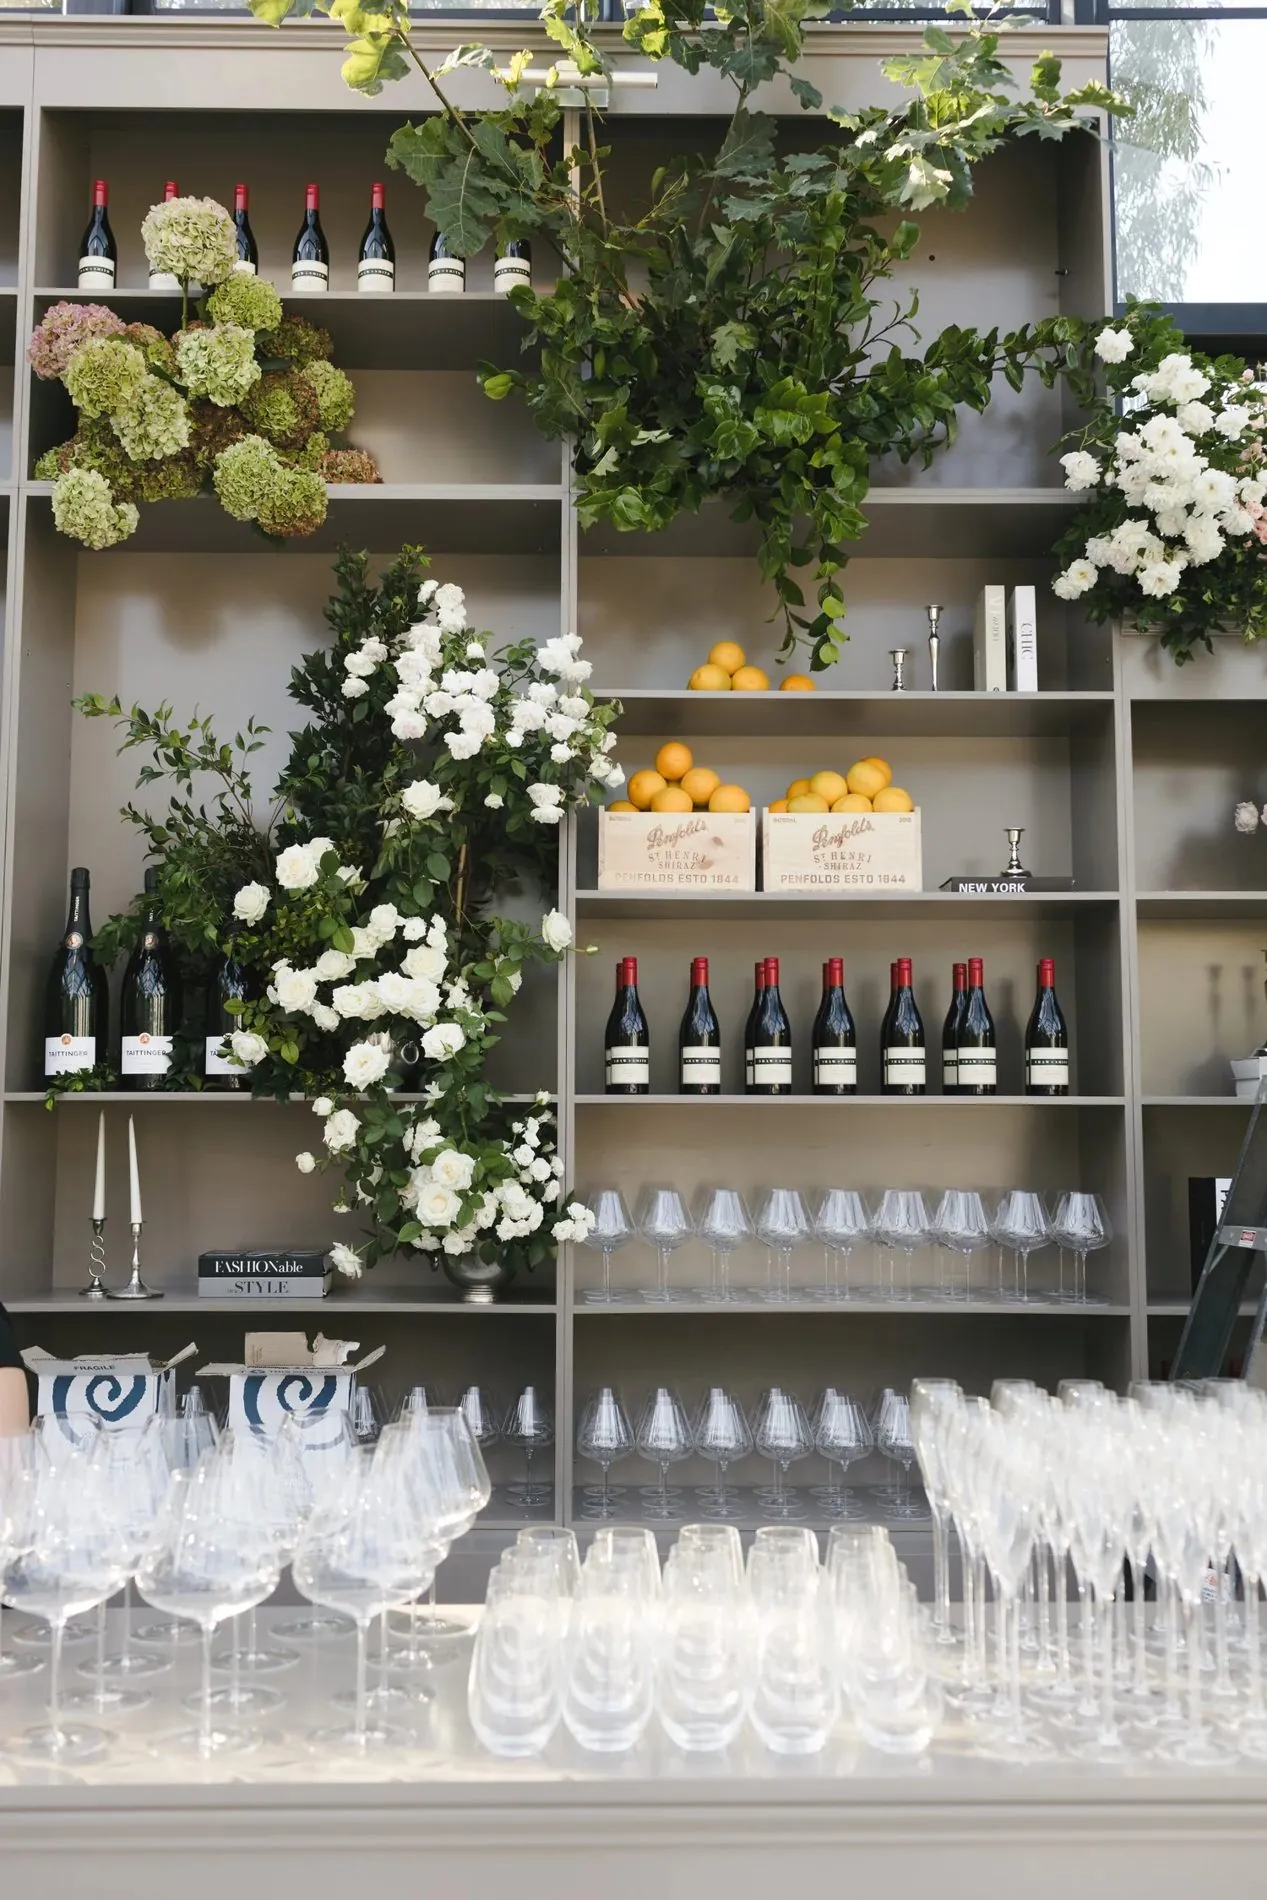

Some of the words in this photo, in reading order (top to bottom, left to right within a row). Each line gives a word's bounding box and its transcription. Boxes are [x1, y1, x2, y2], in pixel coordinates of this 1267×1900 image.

[1021, 622, 1033, 660] CHIC
[658, 861, 697, 870] SHIRAZ
[823, 862, 862, 871] SHIRAZ
[614, 873, 674, 883] PENFOLDS
[711, 874, 739, 884] 1844
[780, 874, 840, 884] PENFOLDS
[878, 874, 906, 884] 1844
[958, 882, 988, 893] NEW
[991, 882, 1026, 893] YORK
[215, 1260, 304, 1273] FASHIONable
[234, 1280, 290, 1293] STYLE
